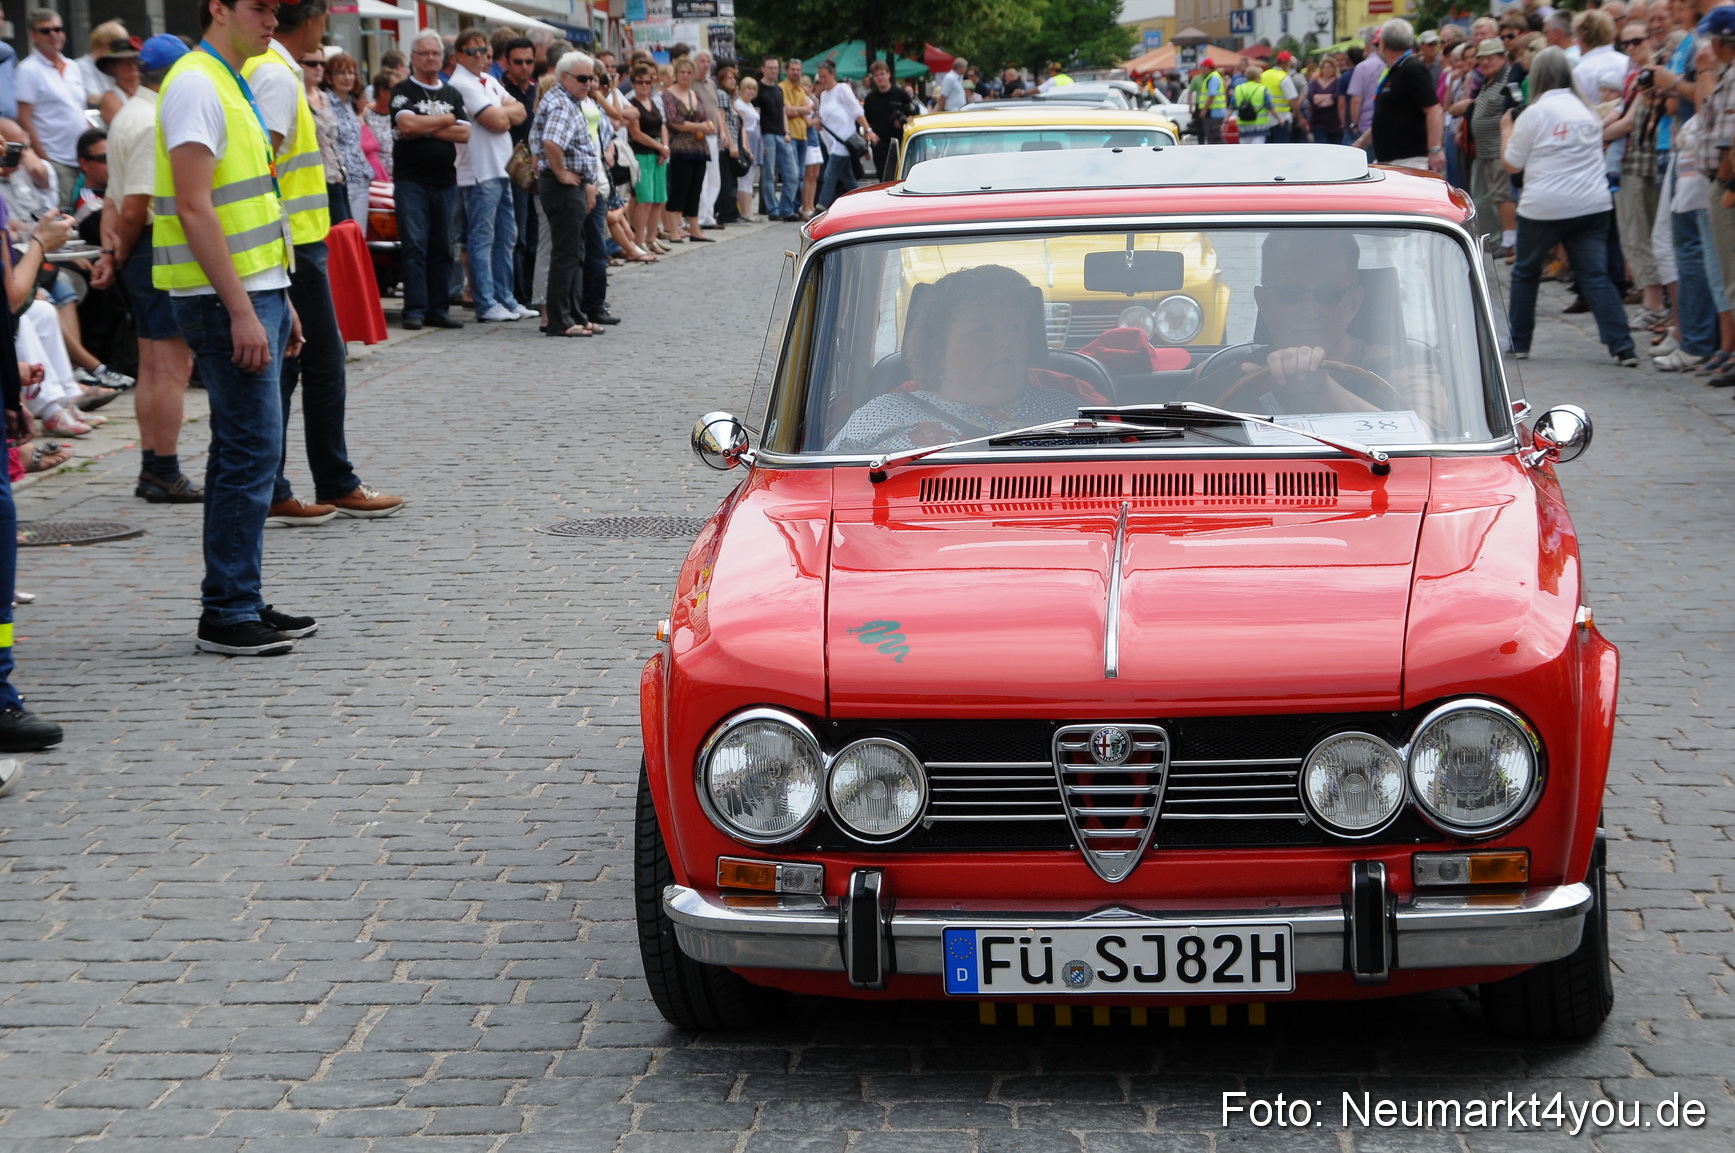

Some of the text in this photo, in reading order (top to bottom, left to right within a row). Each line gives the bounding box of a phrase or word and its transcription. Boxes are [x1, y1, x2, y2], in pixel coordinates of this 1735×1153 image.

[1353, 419, 1398, 432] 38
[1098, 753, 1122, 761] MILANO
[981, 936, 1054, 985] FÜ
[956, 967, 969, 982] D
